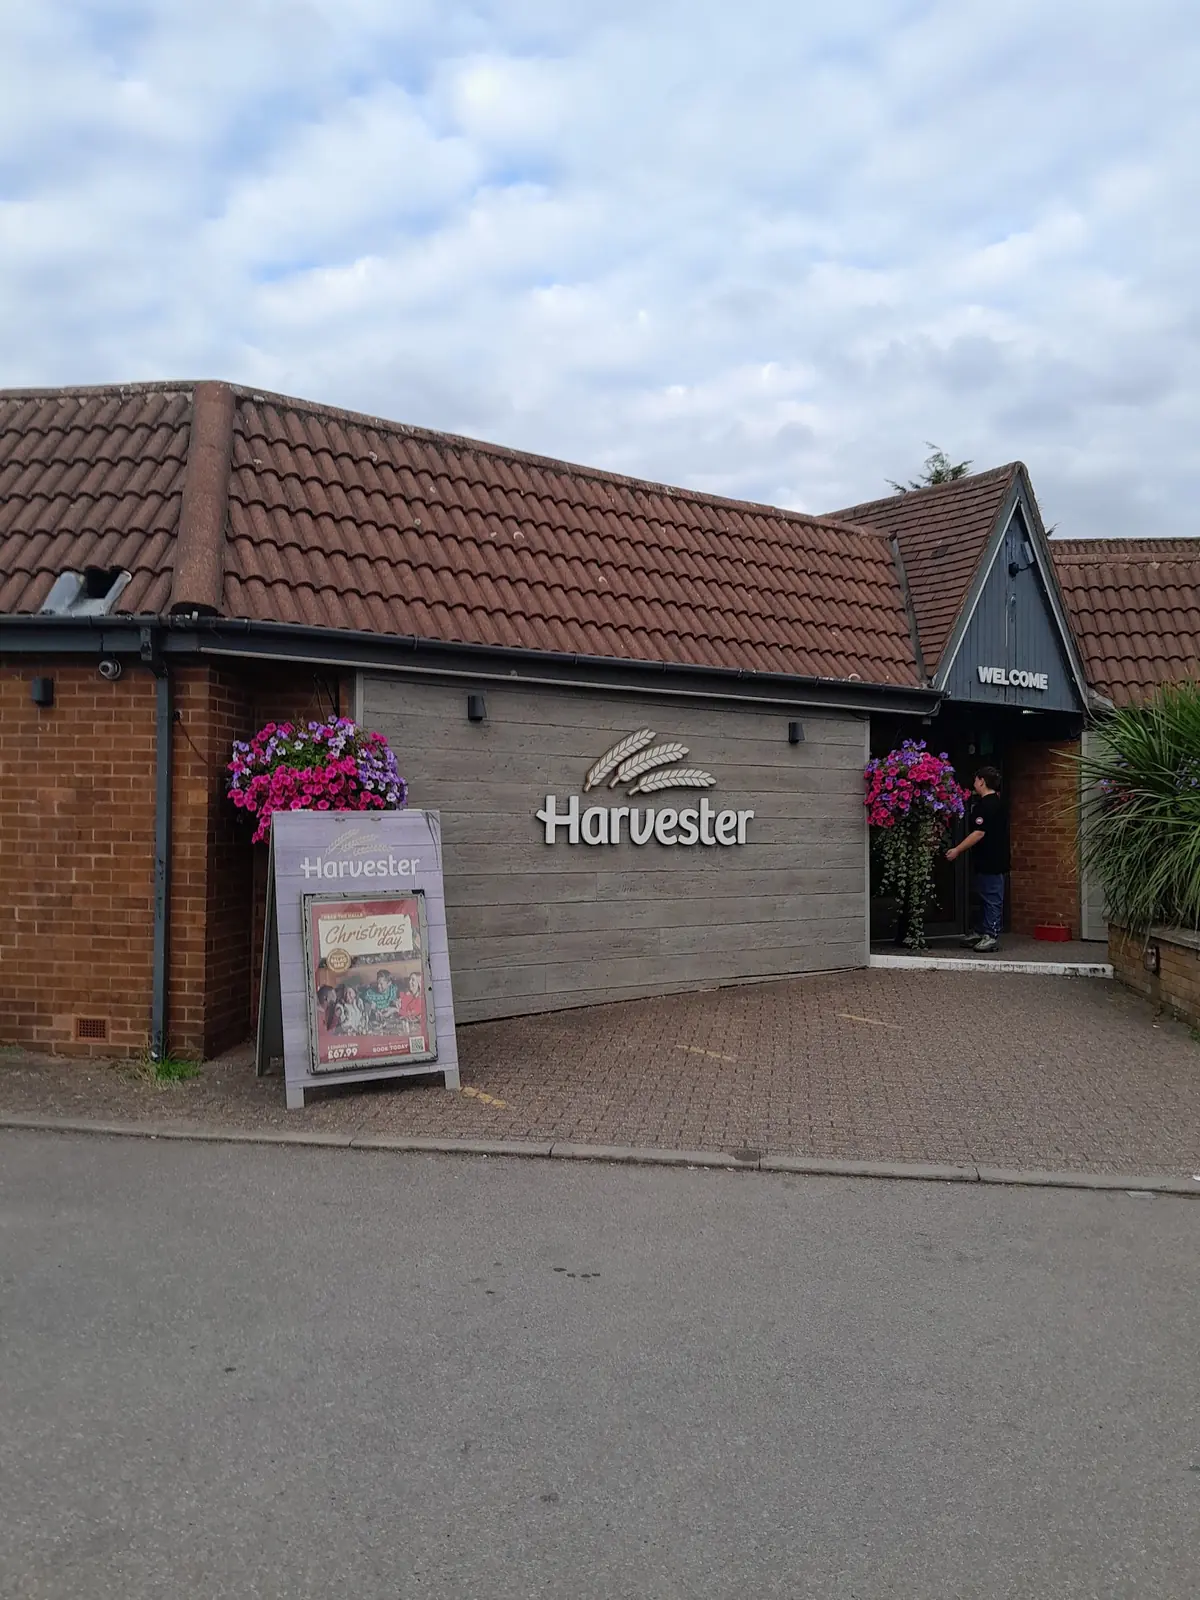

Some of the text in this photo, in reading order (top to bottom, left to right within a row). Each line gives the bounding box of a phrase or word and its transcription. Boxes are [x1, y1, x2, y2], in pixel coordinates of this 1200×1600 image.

[978, 666, 1048, 690] WELCOME
[536, 795, 755, 845] Harvester
[300, 854, 420, 879] Harvester
[325, 922, 406, 945] Christmas
[377, 935, 403, 950] day
[328, 1047, 358, 1060] £67.99
[389, 1043, 409, 1051] TODAY
